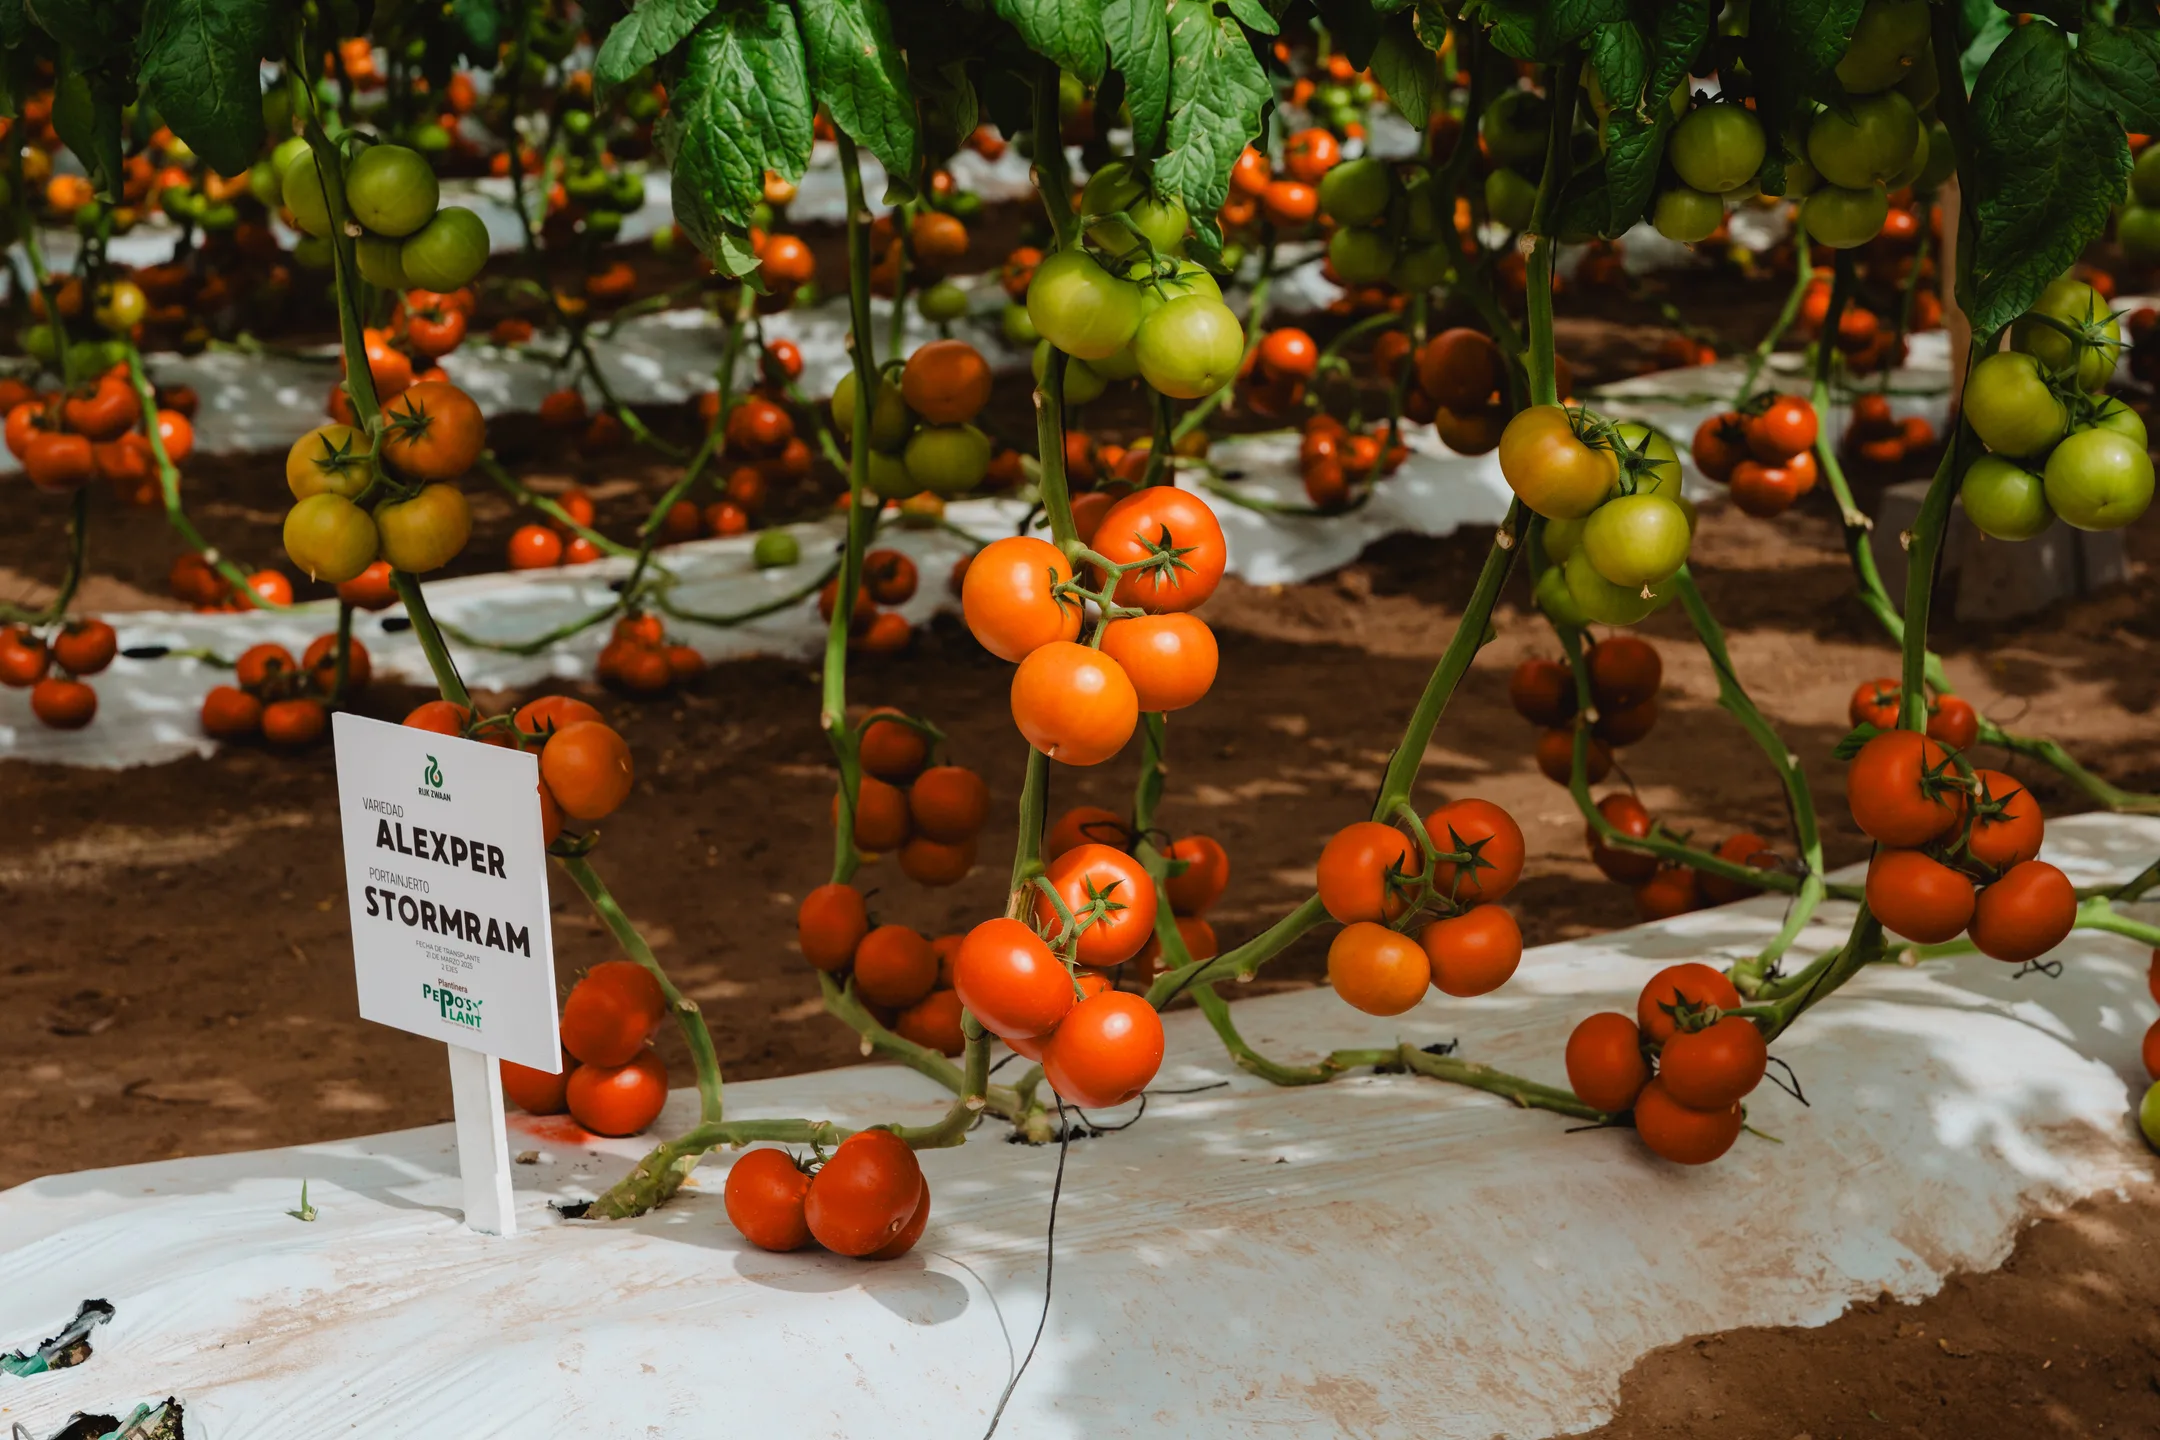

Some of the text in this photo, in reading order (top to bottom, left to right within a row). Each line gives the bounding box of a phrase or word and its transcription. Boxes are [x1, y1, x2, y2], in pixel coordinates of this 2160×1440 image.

[418, 787, 451, 802] RIJK ZWAAN
[362, 797, 404, 818] VARIEDAD
[376, 819, 507, 879] ALEXPER
[369, 867, 430, 893] PORTAINJERTO
[365, 886, 531, 958] STORMRAM
[416, 940, 480, 964] FECHA DE TRANSPLANTE
[432, 953, 440, 961] DE
[440, 955, 460, 966] MARZO
[438, 978, 468, 994] Plantinera
